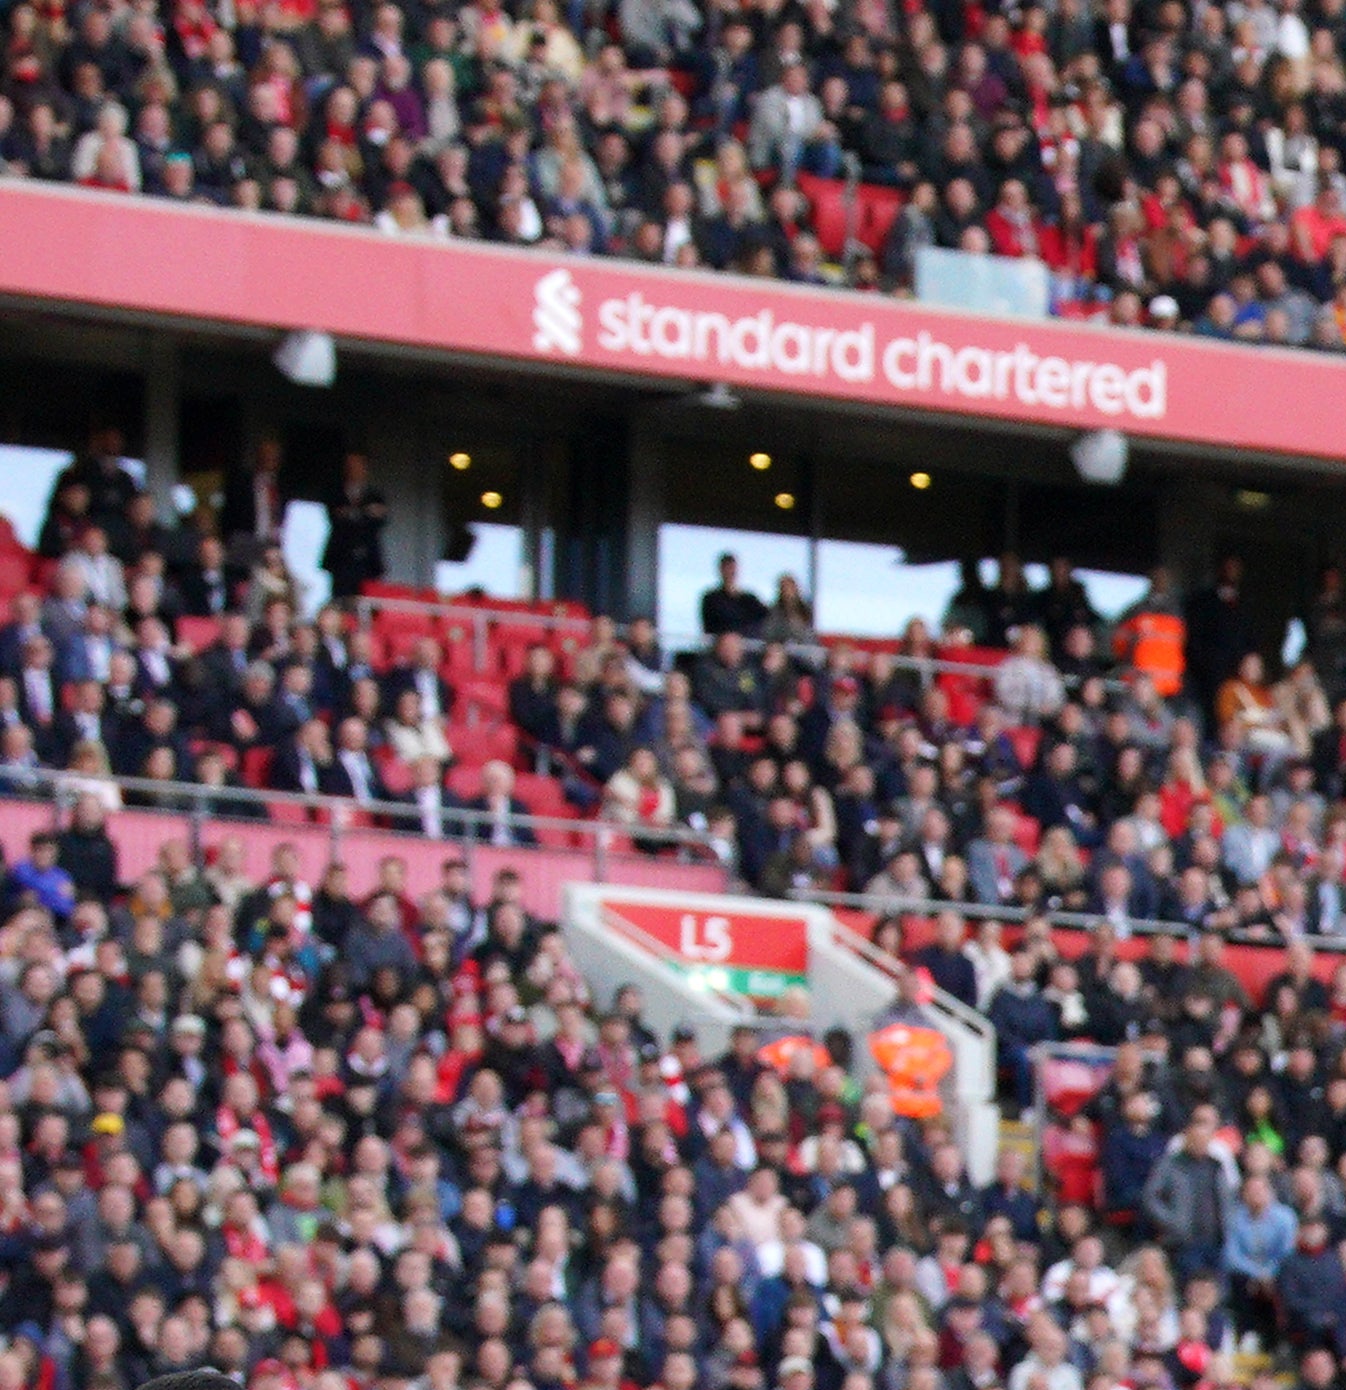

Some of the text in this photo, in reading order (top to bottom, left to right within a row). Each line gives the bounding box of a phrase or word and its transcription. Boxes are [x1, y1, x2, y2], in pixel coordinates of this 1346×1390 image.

[599, 292, 1168, 419] standard chartered
[680, 914, 732, 960] L5
